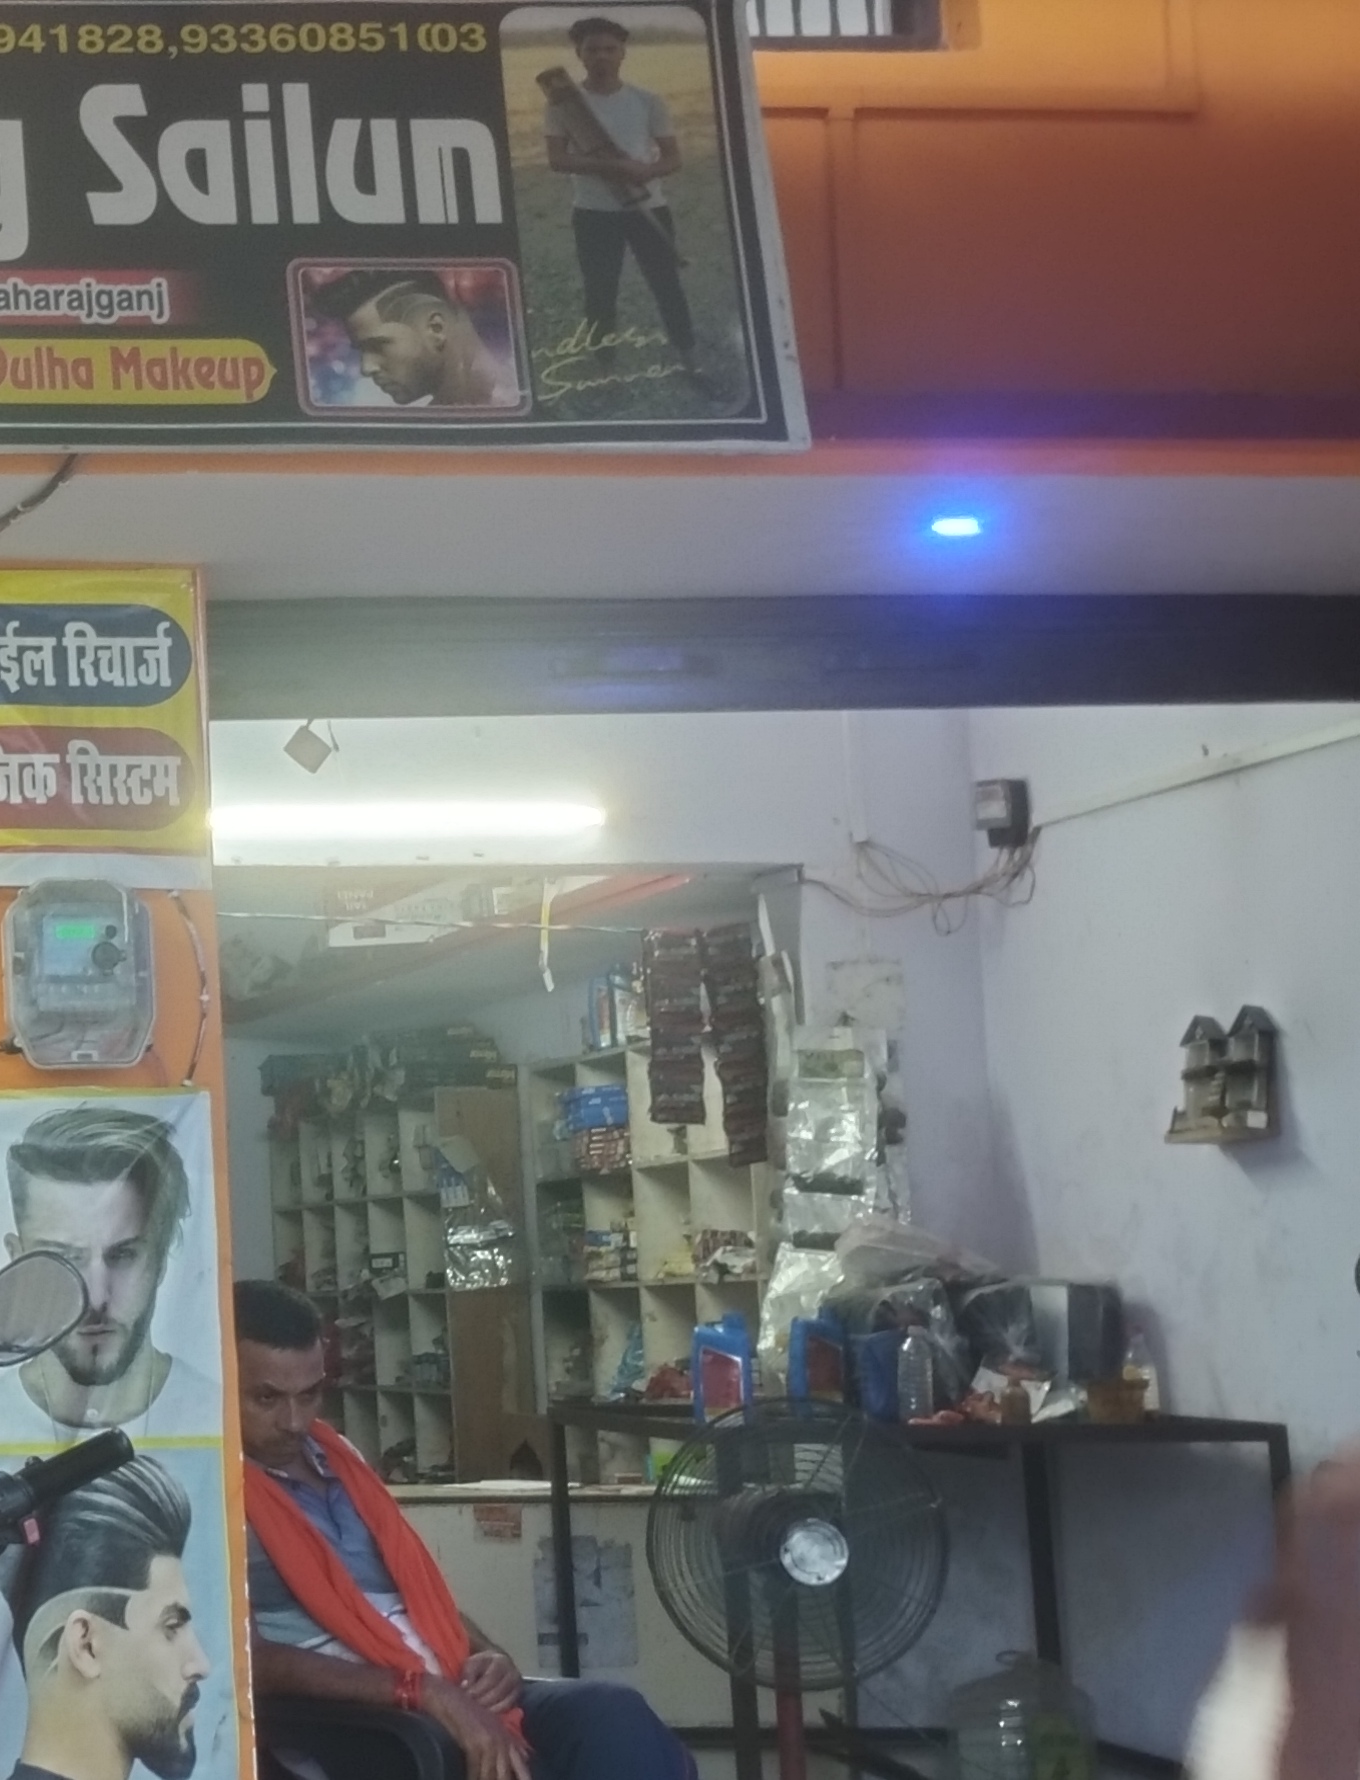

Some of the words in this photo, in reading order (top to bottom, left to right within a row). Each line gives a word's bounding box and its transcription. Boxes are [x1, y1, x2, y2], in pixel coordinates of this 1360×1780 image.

[78, 81, 504, 226] Sailun
[111, 346, 266, 401] Makeup
[61, 620, 173, 689] रिचार्ज
[65, 738, 182, 807] सिस्टम
